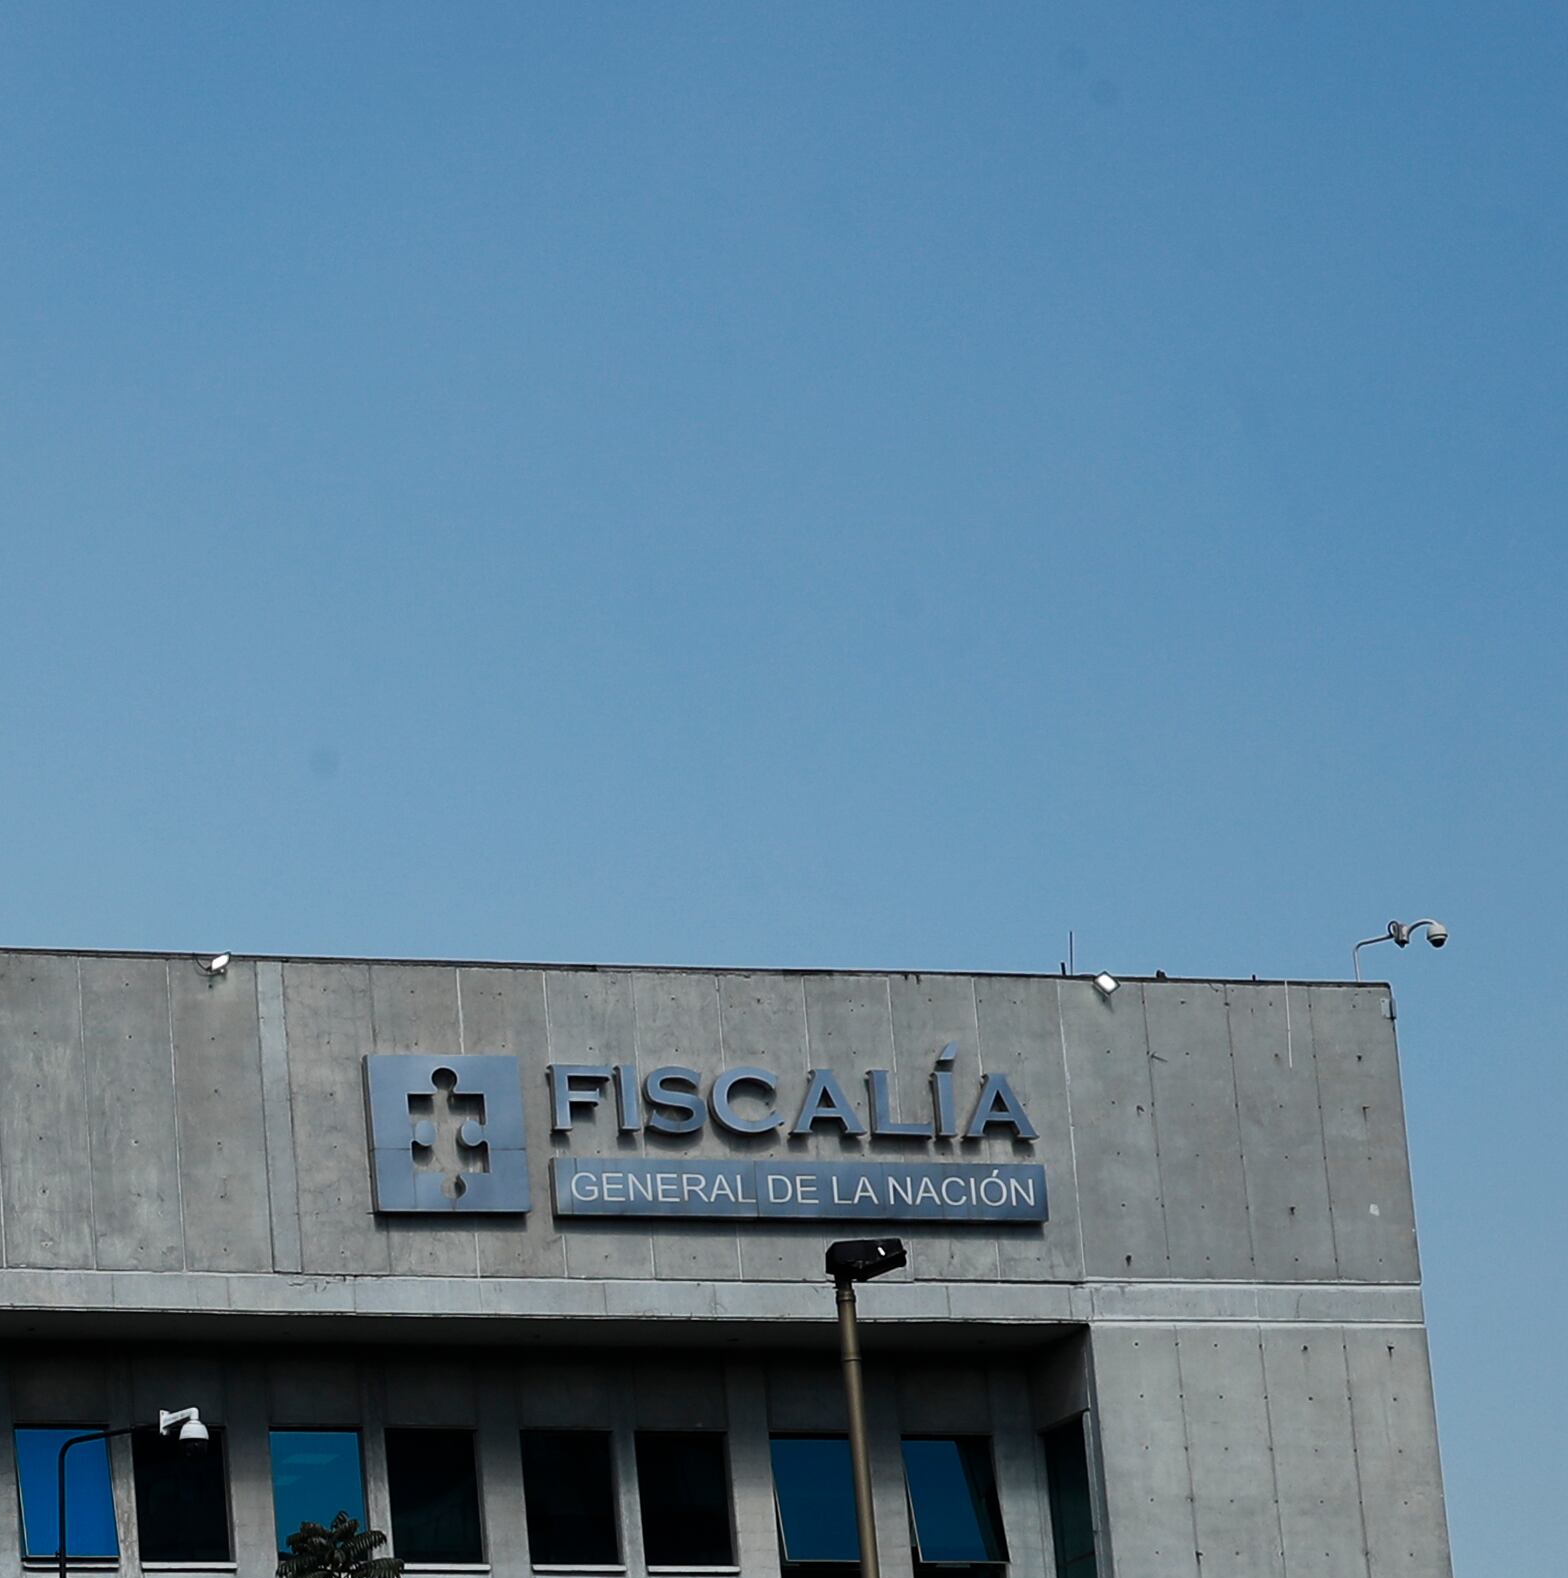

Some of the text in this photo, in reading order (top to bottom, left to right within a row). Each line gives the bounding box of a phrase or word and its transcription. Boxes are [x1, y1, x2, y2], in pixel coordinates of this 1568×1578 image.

[547, 1040, 1041, 1140] FISCALÍA
[570, 1168, 1036, 1207] GENERAL DE LA NACIÓN
